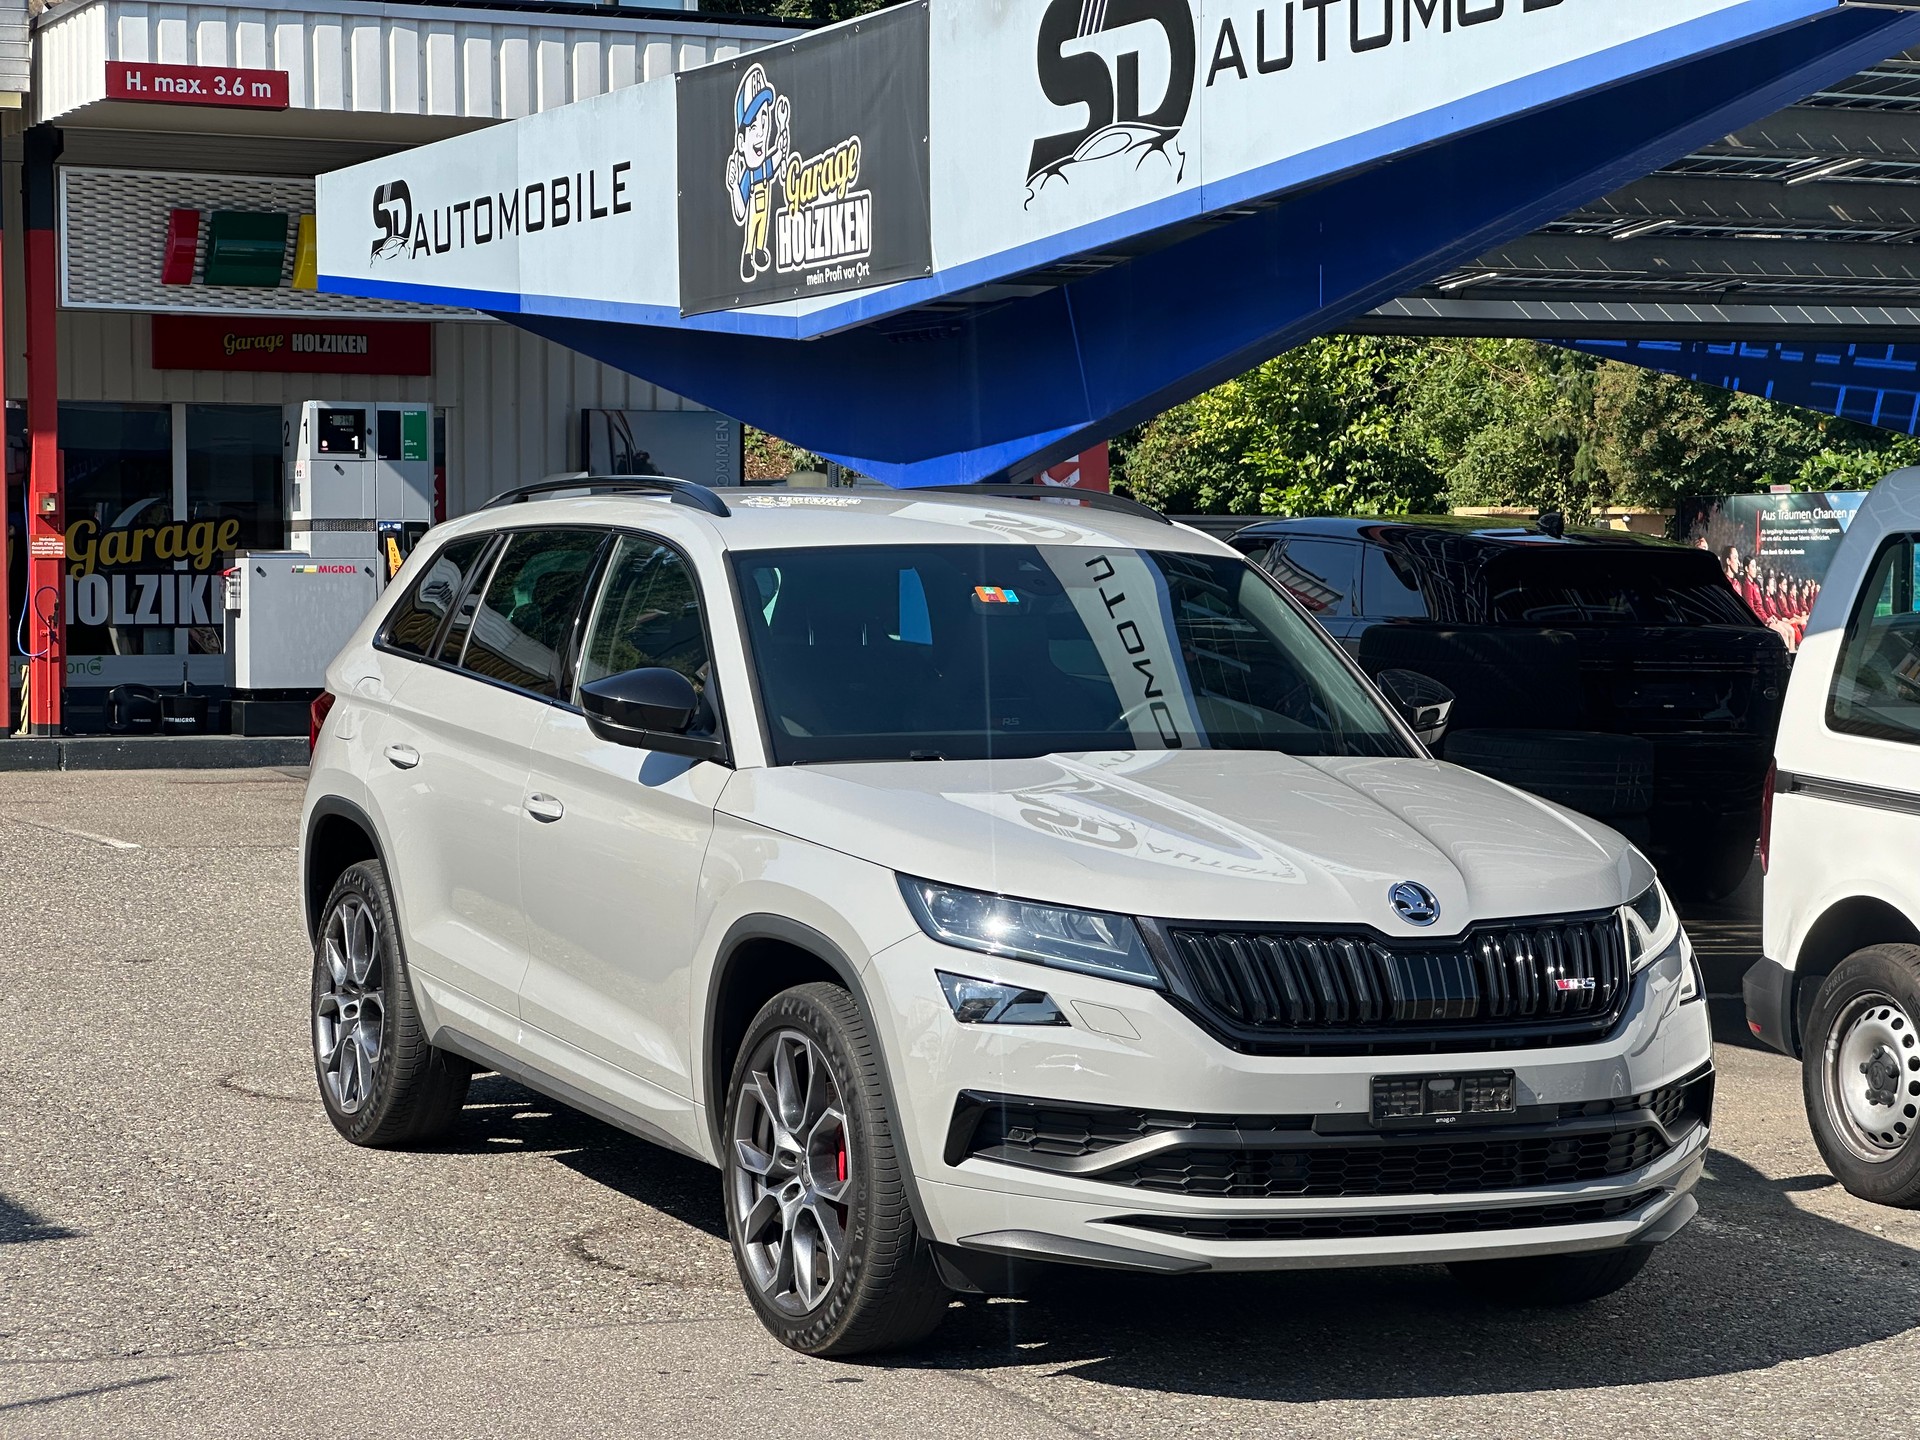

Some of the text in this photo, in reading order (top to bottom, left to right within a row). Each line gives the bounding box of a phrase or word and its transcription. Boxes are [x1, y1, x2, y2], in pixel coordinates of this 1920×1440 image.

[1205, 0, 1564, 87] AUTOM
[126, 71, 271, 98] H. max. 3.6 m
[786, 143, 859, 217] Garage
[411, 160, 633, 260] AUTOMOBILE
[778, 197, 870, 266] HOLZIKEN
[806, 262, 870, 286] mein Profi vor Ort
[223, 333, 368, 355] Garage HOLZIKEN
[351, 435, 359, 450] 1
[1761, 509, 1776, 521] Aus
[1777, 509, 1811, 520] Träumen
[1813, 507, 1847, 519] Chancen
[65, 519, 240, 581] Garage
[318, 565, 358, 574] MIGROL
